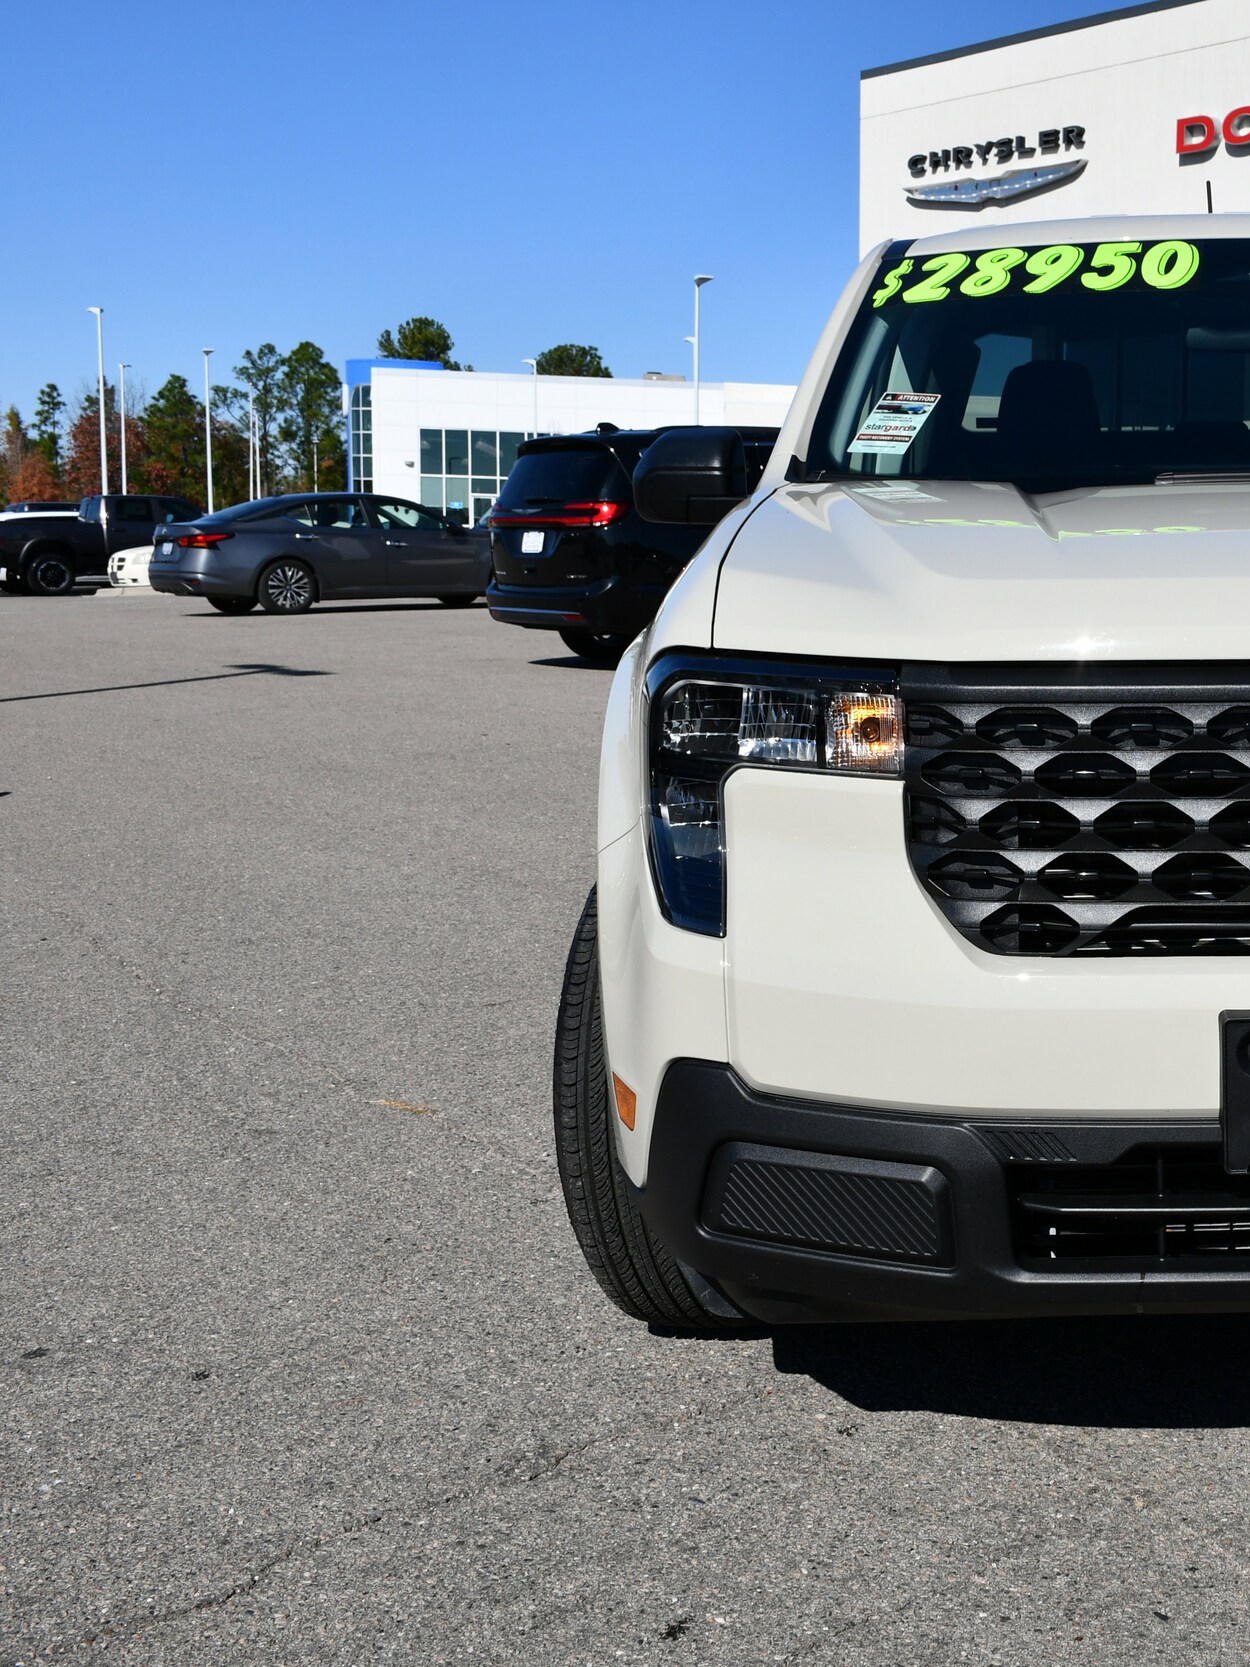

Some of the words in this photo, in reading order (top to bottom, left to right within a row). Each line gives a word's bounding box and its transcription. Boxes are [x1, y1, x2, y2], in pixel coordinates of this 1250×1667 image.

[907, 125, 1086, 173] CHRYSLER
[872, 241, 1200, 308] $28950
[897, 394, 935, 402] ATTENTION
